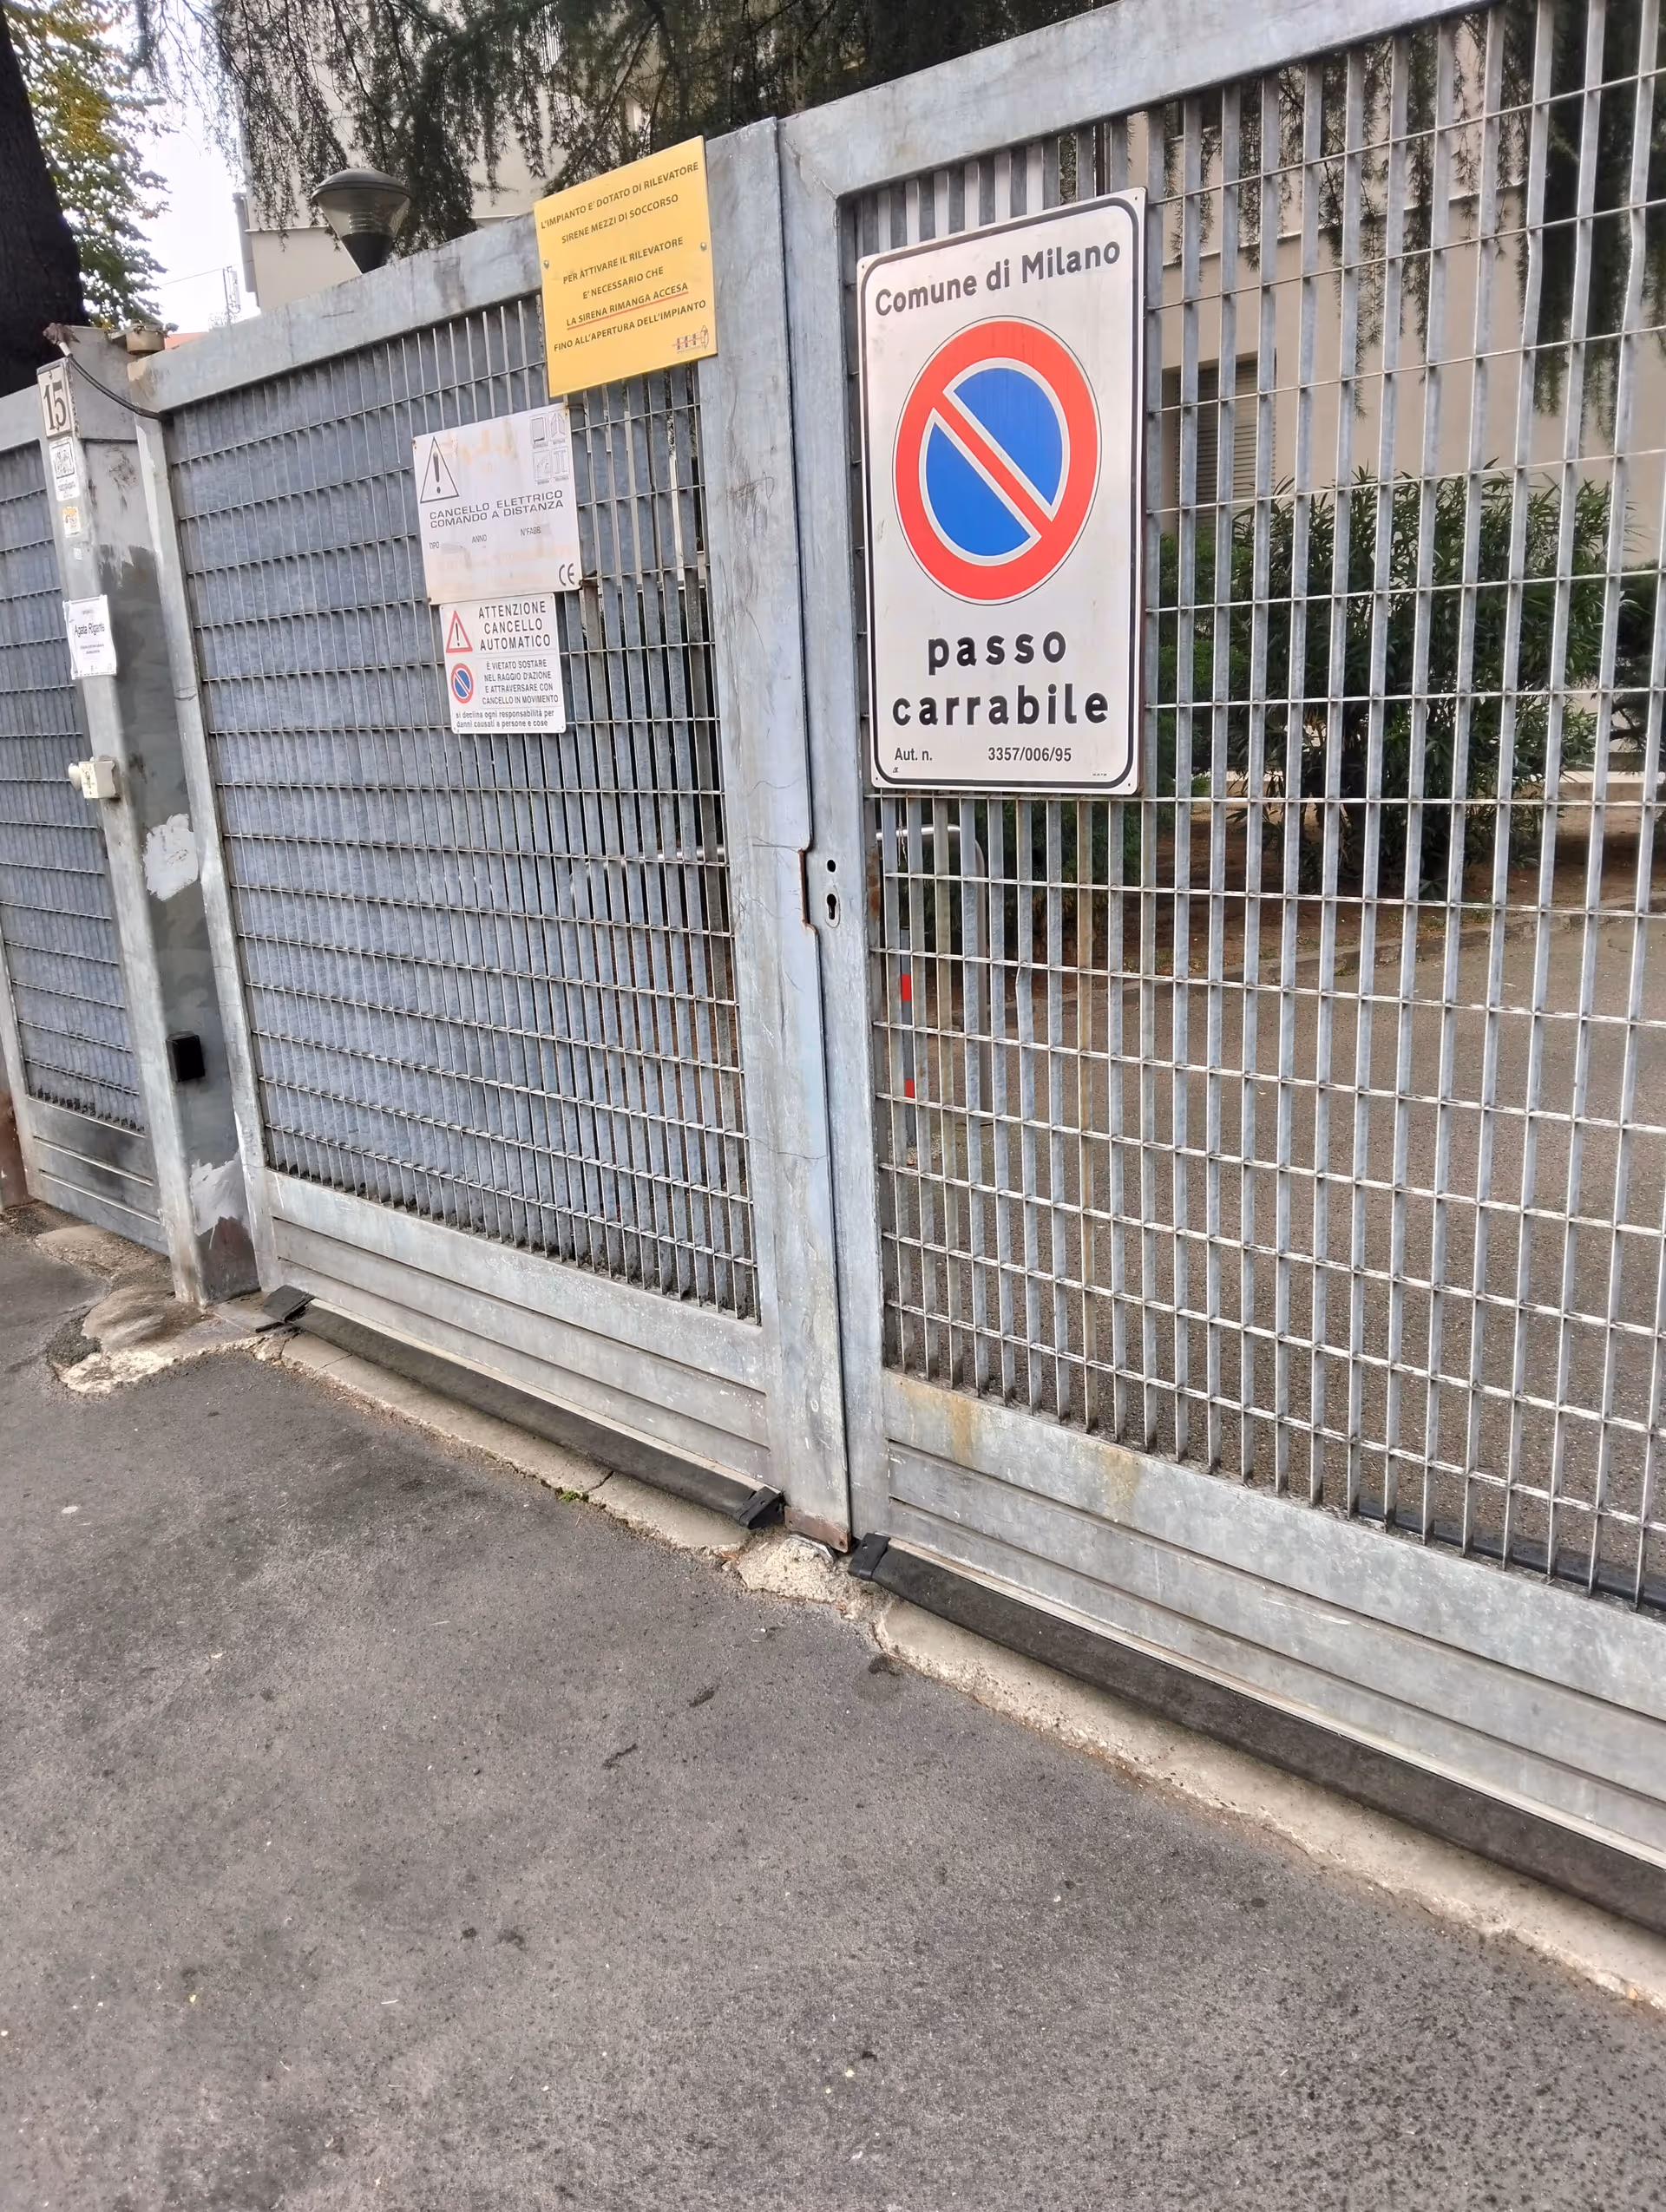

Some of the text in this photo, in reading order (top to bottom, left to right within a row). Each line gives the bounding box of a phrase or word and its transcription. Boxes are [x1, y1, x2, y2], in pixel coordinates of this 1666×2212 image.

[541, 161, 699, 229] L'IMPIANTO E' DOTATO DI RILEVATORE
[561, 193, 679, 244] SIRENE MEZZI DI SOCCORSO
[562, 236, 684, 285] PER ATTIVARE IL RILEVATORE
[582, 265, 664, 299] E' NECESSARIO CHE
[875, 239, 1121, 317] Comune di Milano
[566, 282, 688, 327] LA SIRENA RIMANGA ACCESA
[554, 299, 706, 351] FINO ALL'APERTURA DELL'IMPIANTO
[43, 381, 68, 431] 15
[430, 489, 563, 520] CANCELLO ELETTRICO
[430, 500, 564, 529] COMANDO A DISTANZA
[471, 534, 488, 543] ANNO
[558, 563, 575, 586] CE
[478, 600, 547, 619] ATTENZIONE
[484, 618, 543, 635] CANCELLO
[480, 634, 551, 651] AUTOMATICO
[928, 630, 1066, 676] passo
[486, 659, 548, 671] È VIETATO SOSTARE
[497, 672, 521, 681] RAGGIO
[522, 671, 552, 680] D'AZIONE
[482, 697, 514, 705] CANCELLO
[521, 694, 559, 704] MOVIMENTO
[490, 684, 538, 693] ATTRAVERSARE
[539, 683, 554, 691] CON
[462, 710, 483, 719] declina
[484, 710, 497, 720] ogni
[498, 709, 542, 719] responsabilità
[543, 710, 554, 719] per
[893, 684, 1110, 728] carrabile
[473, 719, 495, 728] causati
[501, 719, 527, 729] persone
[895, 747, 1072, 762] Aut. n. 3357/006/95
